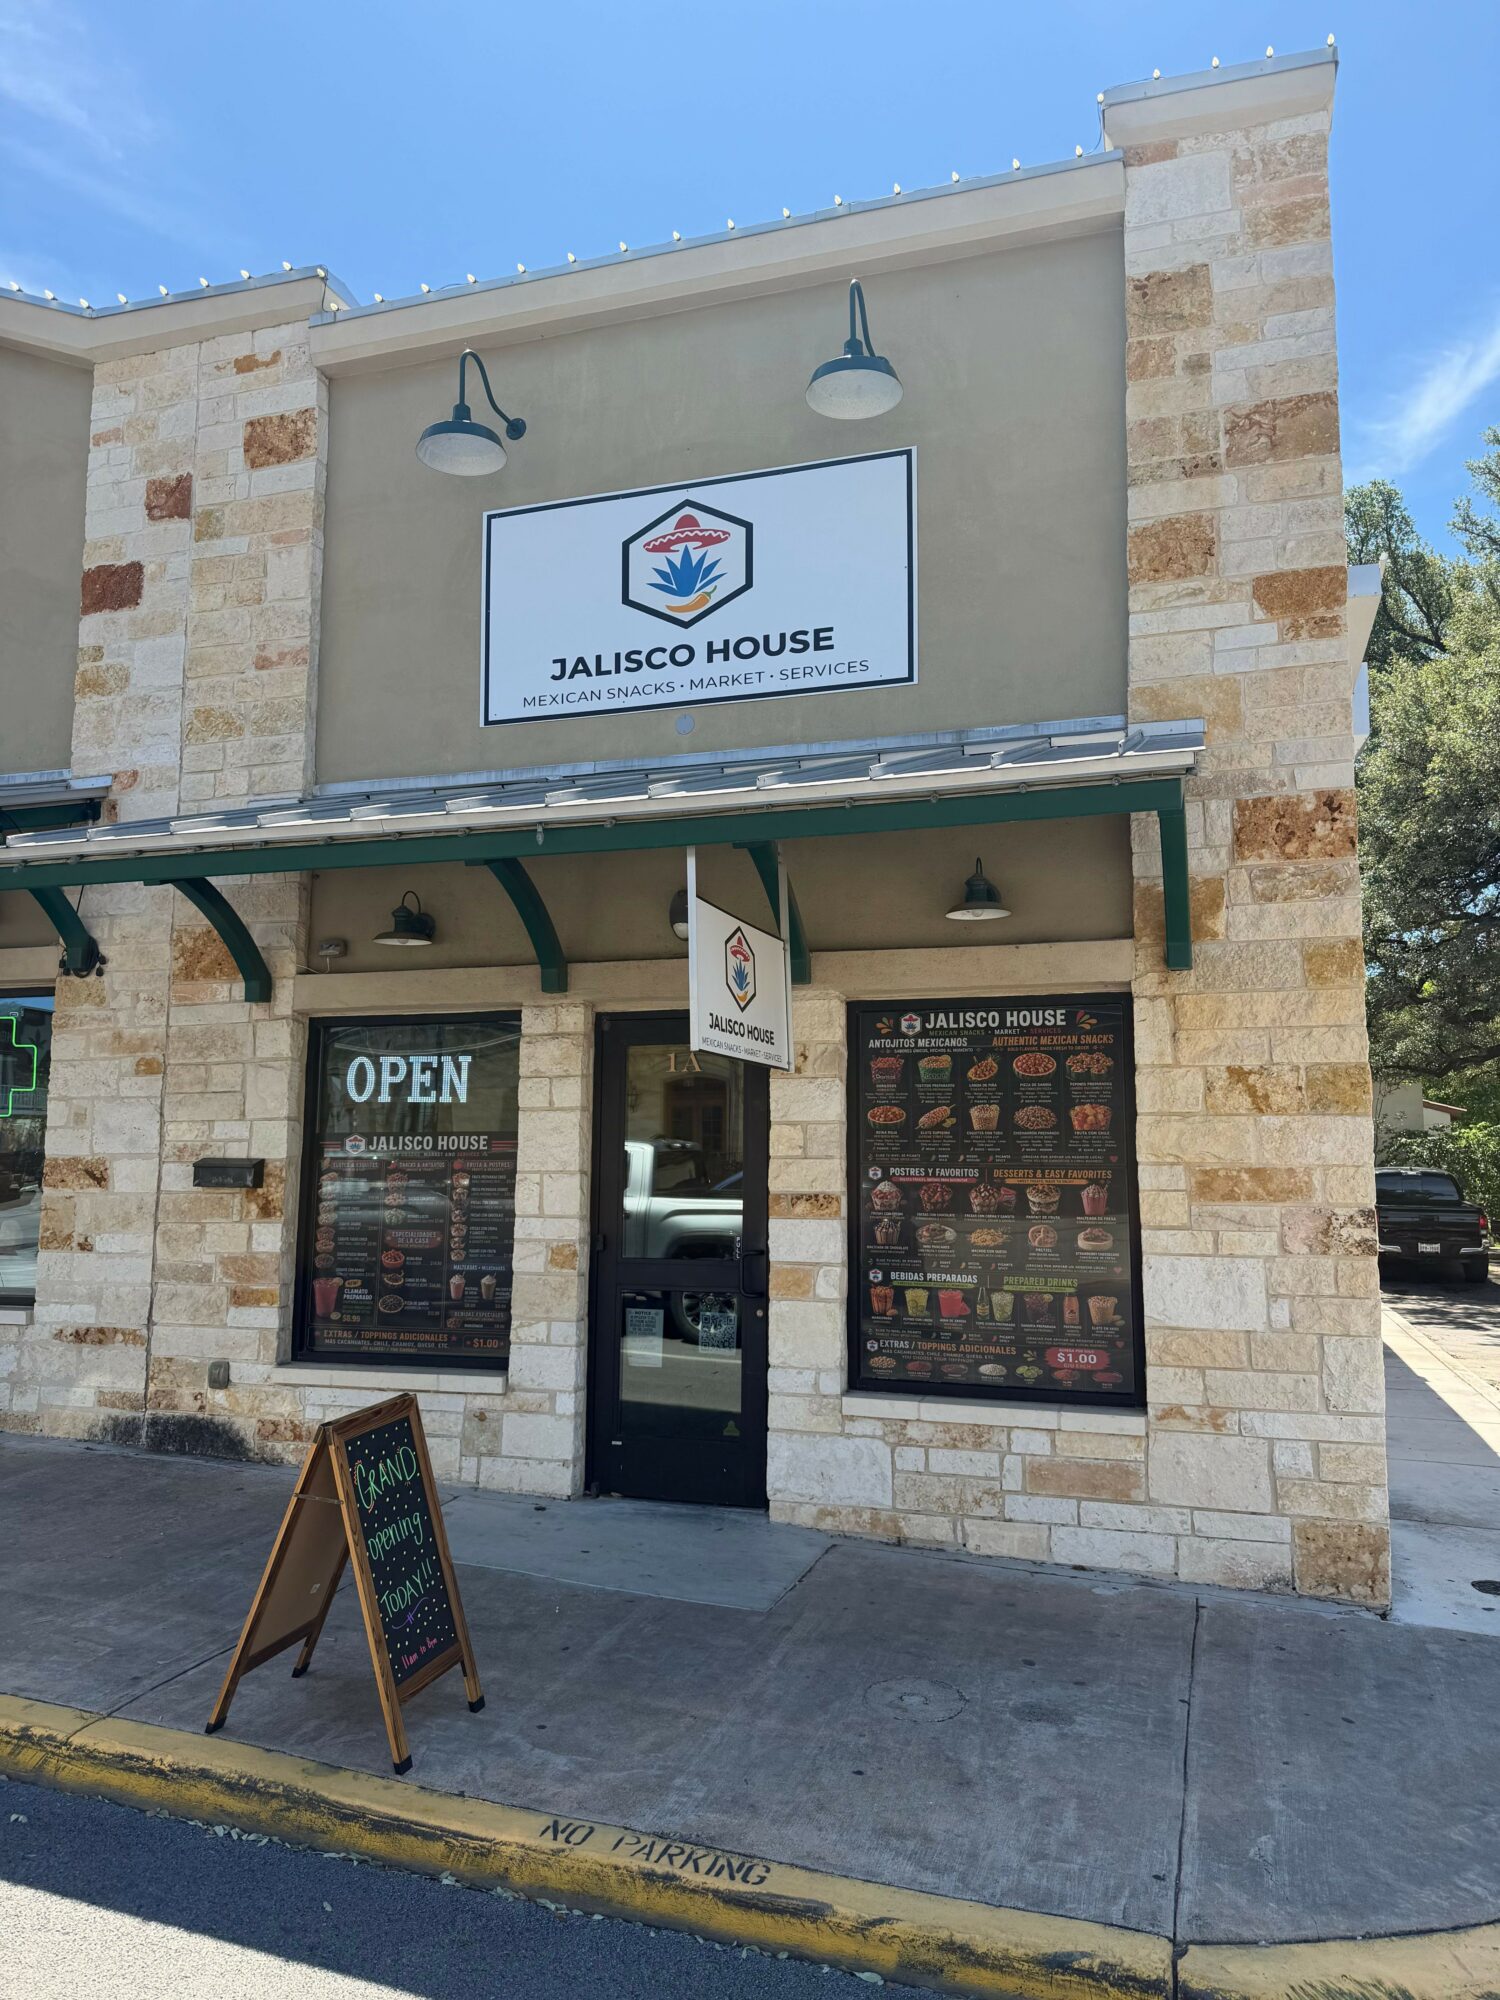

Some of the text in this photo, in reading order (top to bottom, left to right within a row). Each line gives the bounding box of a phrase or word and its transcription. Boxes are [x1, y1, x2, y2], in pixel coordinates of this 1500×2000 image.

[551, 626, 834, 681] JALISCO HOUSE
[523, 660, 869, 708] MEXICAN SNACKS MARKET SERVICES
[925, 1010, 1066, 1028] JALISCO HOUSE
[709, 1012, 774, 1045] JALISCO HOUSE
[869, 1038, 967, 1048] ANTOJITOS MEXICANOS
[992, 1034, 1114, 1046] AUTHENTIC MEXICAN SNACKS
[702, 1036, 782, 1062] MEXICAN SNACKS MARKET SERVICES
[347, 1056, 472, 1103] OPEN
[369, 1135, 488, 1150] JALISCO HOUSE
[890, 1167, 979, 1177] POSTRES Y FAVORITOS
[994, 1169, 1034, 1178] DESSERTS
[1045, 1170, 1065, 1178] EASY
[1068, 1170, 1112, 1179] FAVORITES
[890, 1272, 977, 1283] BEBIDAS PREPARADAS
[1004, 1276, 1078, 1287] PREPARED DRINKS
[324, 1330, 352, 1338] EXTRAS
[400, 1332, 448, 1342] ADICIONALES
[473, 1338, 498, 1348] $1.00
[880, 1340, 1016, 1355] EXTRAS / TOPPINGS ADICIONALES
[1058, 1352, 1096, 1364] $1.00
[356, 1446, 418, 1510] GRAND
[368, 1512, 423, 1561] opening
[380, 1557, 432, 1619] TODAY!!
[540, 1820, 771, 1886] NO PARKING
